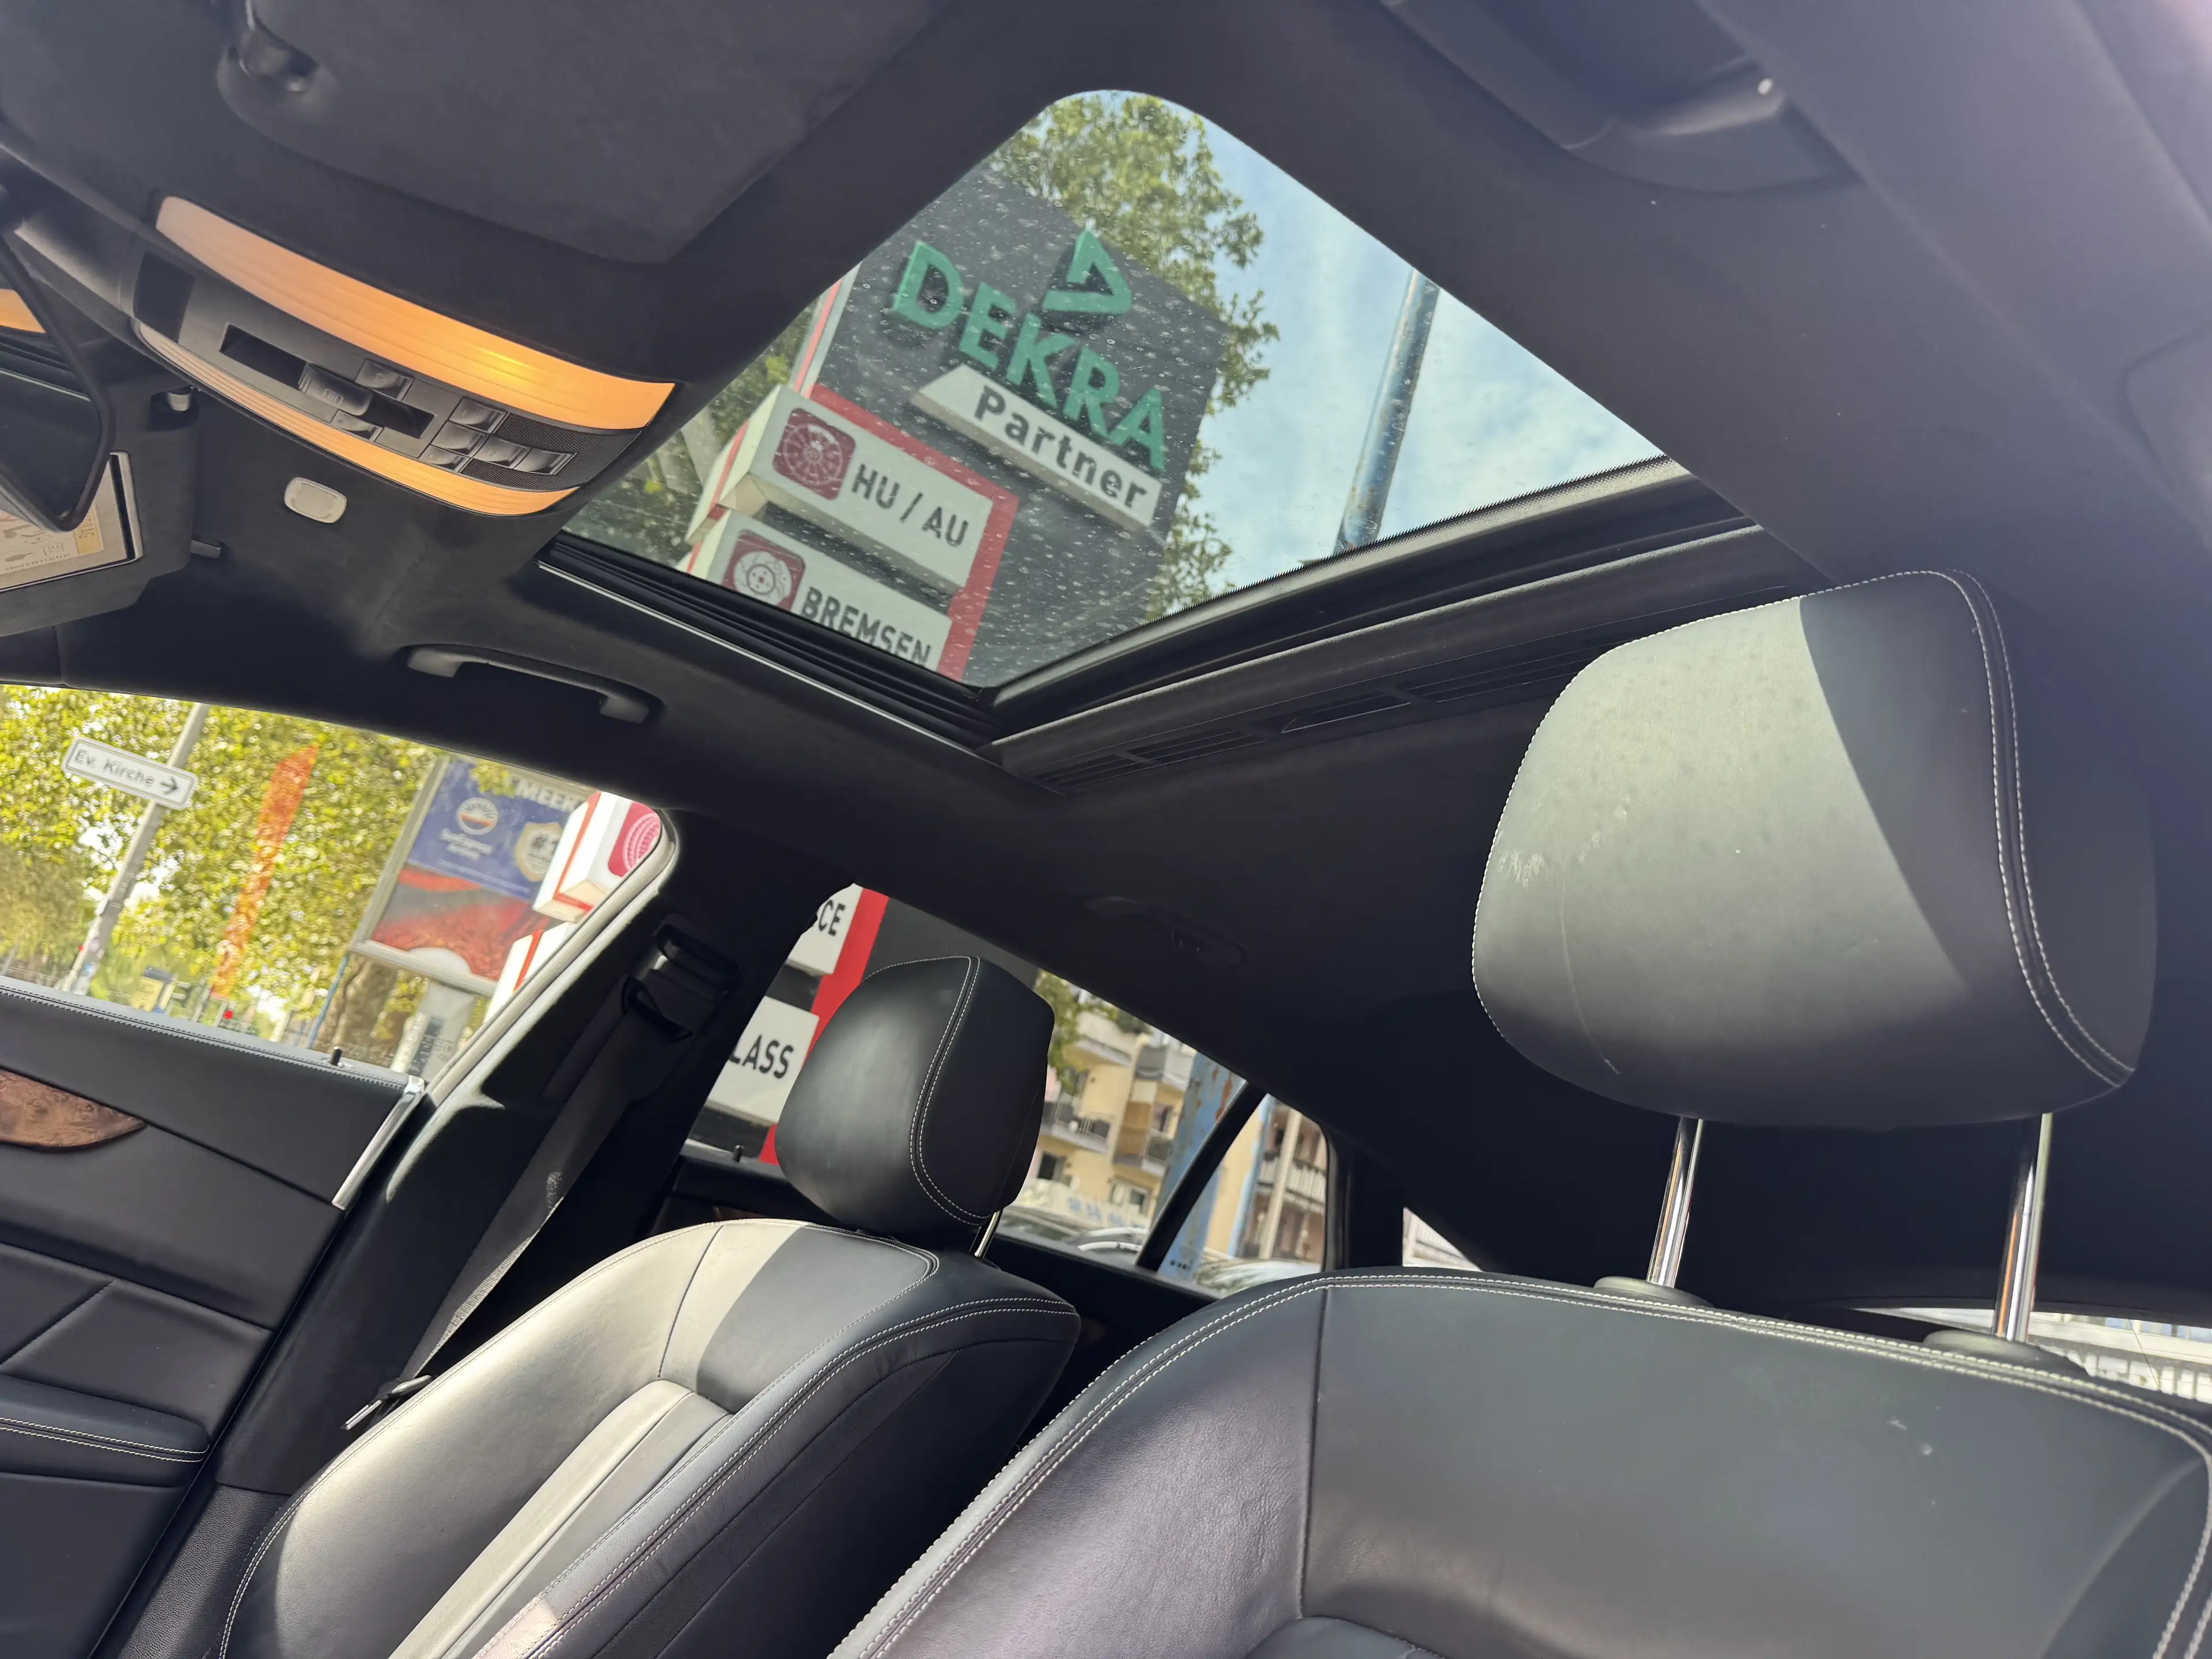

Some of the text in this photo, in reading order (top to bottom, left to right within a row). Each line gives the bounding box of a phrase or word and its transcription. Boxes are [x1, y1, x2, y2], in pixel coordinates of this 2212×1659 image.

[893, 241, 1165, 471] DEKRA
[974, 385, 1147, 509] Partner
[851, 463, 969, 547] HU / AU
[801, 586, 931, 666] BREMSEN
[102, 758, 154, 787] Kirche
